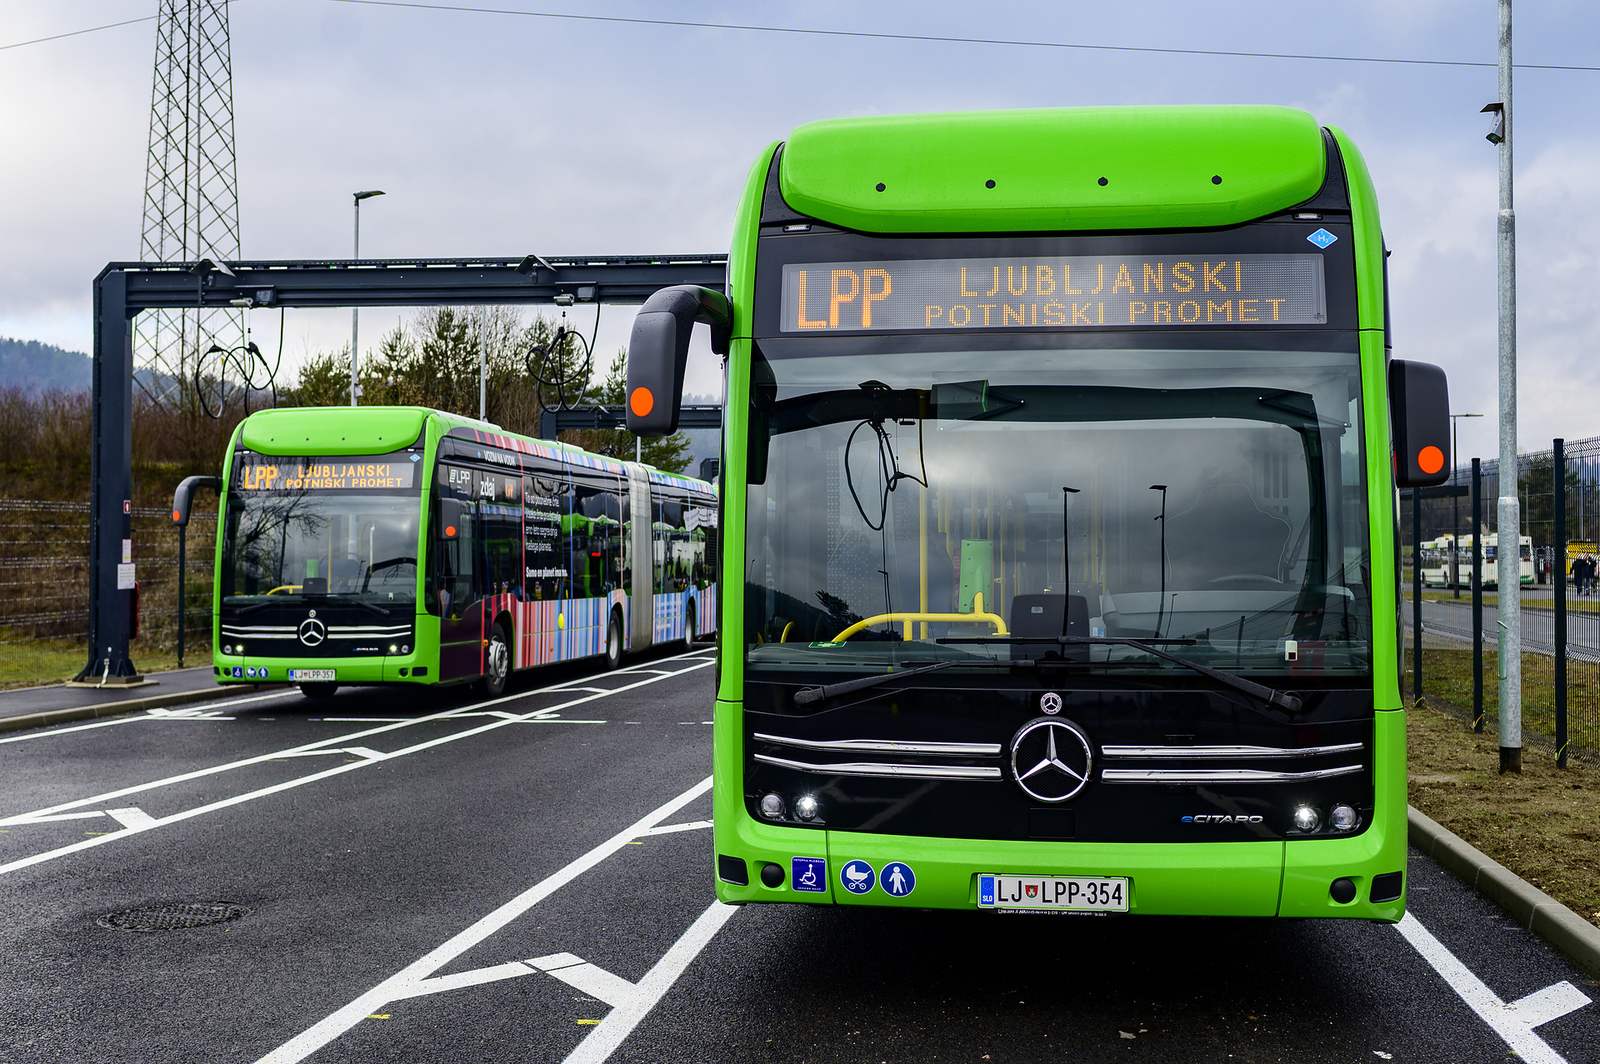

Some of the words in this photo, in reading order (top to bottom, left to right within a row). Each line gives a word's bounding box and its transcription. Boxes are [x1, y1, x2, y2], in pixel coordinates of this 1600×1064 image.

[960, 261, 1241, 297] LJUBLJANSKI
[797, 268, 893, 329] LPP
[925, 299, 1104, 328] POTNIŠKI
[1129, 298, 1286, 325] PROMET
[244, 465, 279, 489] LPP
[298, 464, 391, 478] LJUBLJANSKI
[351, 478, 402, 488] PROMET
[456, 470, 471, 484] LPP
[480, 477, 495, 501] zdaj
[1180, 814, 1264, 824] eCITARO
[982, 894, 994, 903] SLO
[997, 879, 1022, 903] LJ
[1041, 880, 1123, 906] LPP-354
